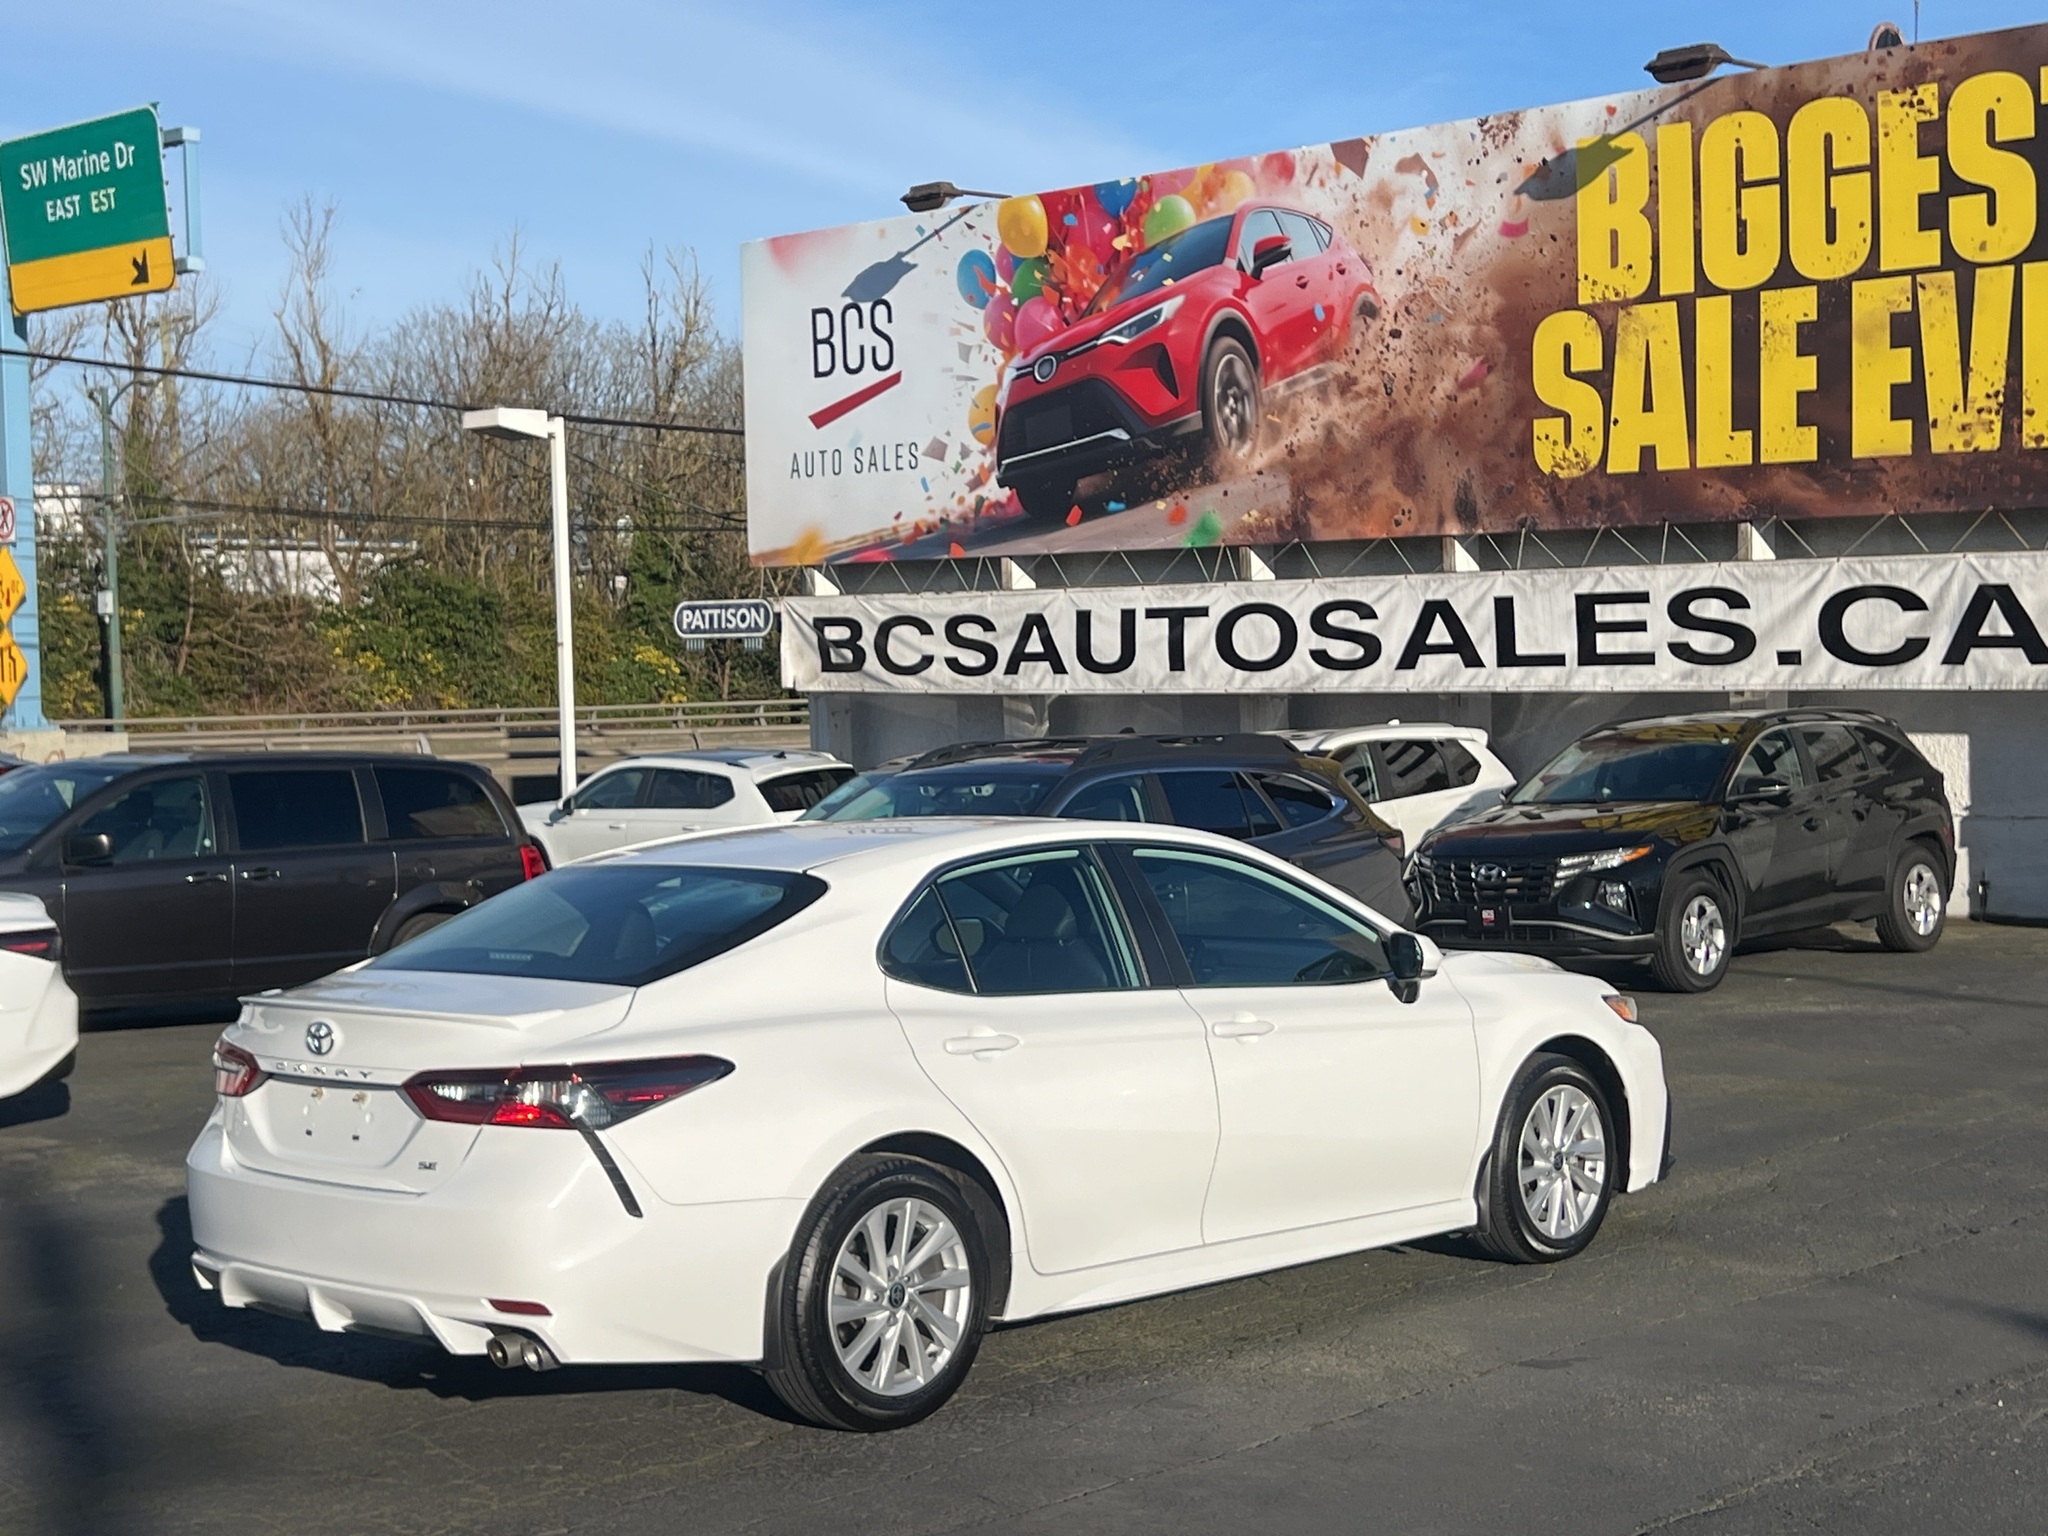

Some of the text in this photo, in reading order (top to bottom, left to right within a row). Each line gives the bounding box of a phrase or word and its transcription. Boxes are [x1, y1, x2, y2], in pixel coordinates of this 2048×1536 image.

[20, 141, 136, 190] SW Marine Dr
[1576, 65, 2048, 305] BIGGES
[46, 188, 116, 222] EAST EST
[811, 298, 894, 378] BCS
[1532, 285, 1818, 479] SALE
[790, 442, 918, 479] AUTO SALES
[681, 606, 765, 632] PATTISON
[812, 583, 2048, 677] BCSAUTOSALES.CA
